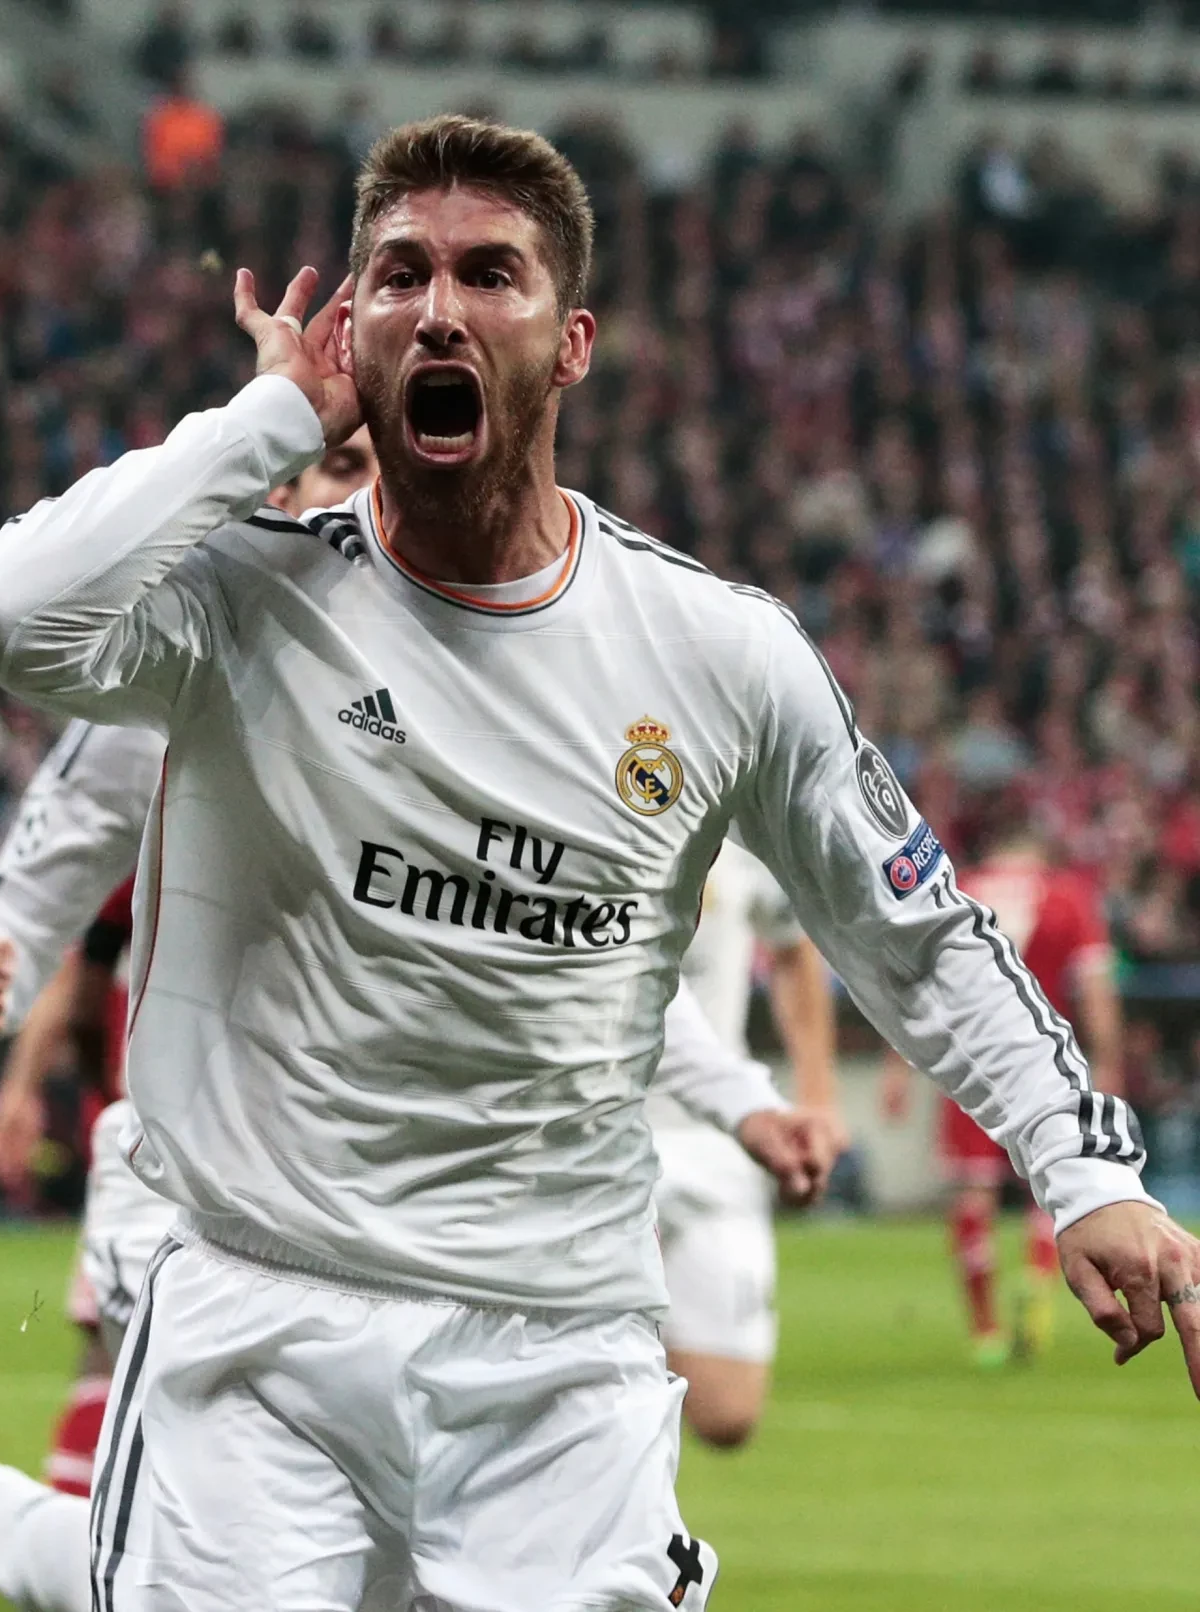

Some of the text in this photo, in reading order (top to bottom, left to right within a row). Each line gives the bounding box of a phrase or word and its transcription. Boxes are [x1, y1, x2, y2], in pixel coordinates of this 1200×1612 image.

[337, 709, 407, 744] adidas
[883, 790, 896, 811] 9
[476, 816, 565, 884] Fly
[911, 827, 940, 870] RESPEC
[353, 840, 639, 947] Emirates
[667, 1533, 704, 1609] 4
